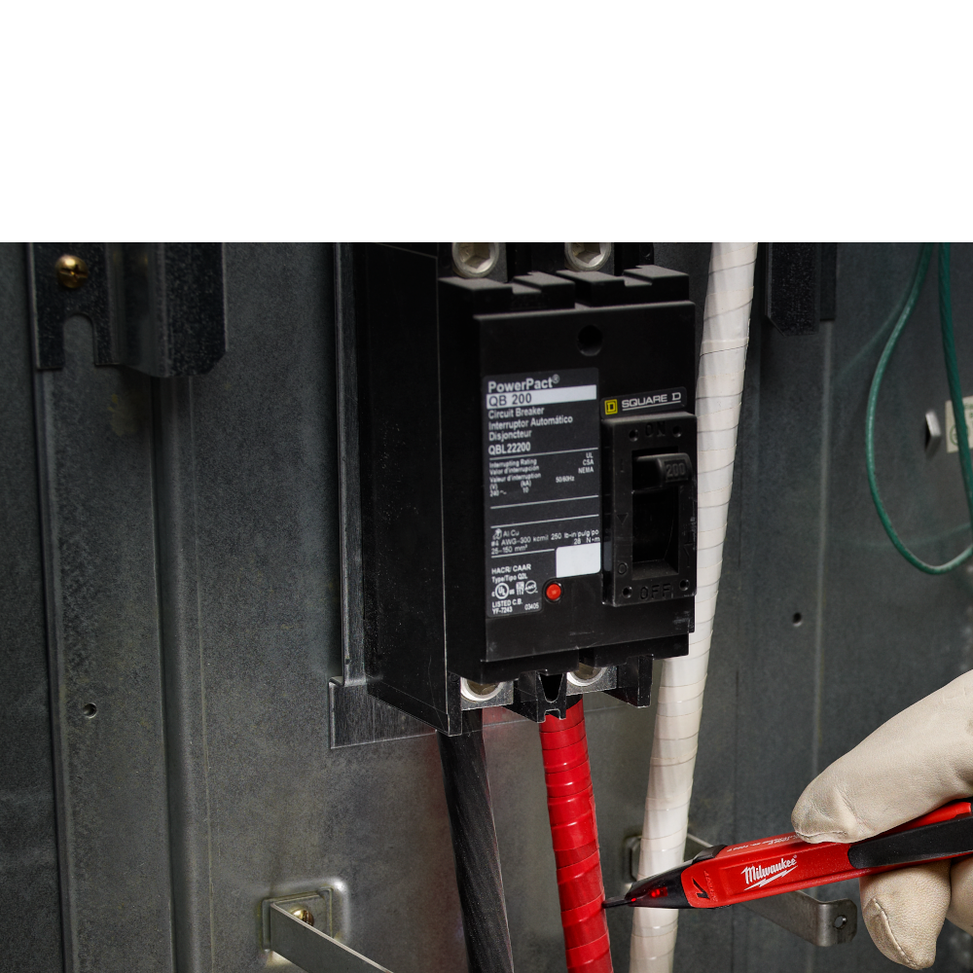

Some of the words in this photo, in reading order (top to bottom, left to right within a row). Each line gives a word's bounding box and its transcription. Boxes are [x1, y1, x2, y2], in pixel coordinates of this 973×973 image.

[488, 395, 507, 407] QB
[512, 393, 532, 405] 200
[622, 394, 667, 408] SQUARE
[672, 392, 681, 401] D
[488, 409, 513, 419] Circuit
[515, 407, 544, 417] Breaker
[488, 420, 528, 430] Interruptor
[530, 415, 573, 427] Automático
[489, 430, 532, 442] Disjoncteur
[488, 442, 531, 455] QBL22200
[489, 461, 519, 469] Interrupting
[578, 466, 594, 474] NEMA
[666, 462, 686, 477] 200
[533, 533, 549, 541] kcmil
[551, 532, 562, 540] 250
[513, 564, 531, 572] CAAR
[640, 583, 671, 600] OFF
[492, 600, 511, 608] LISTED
